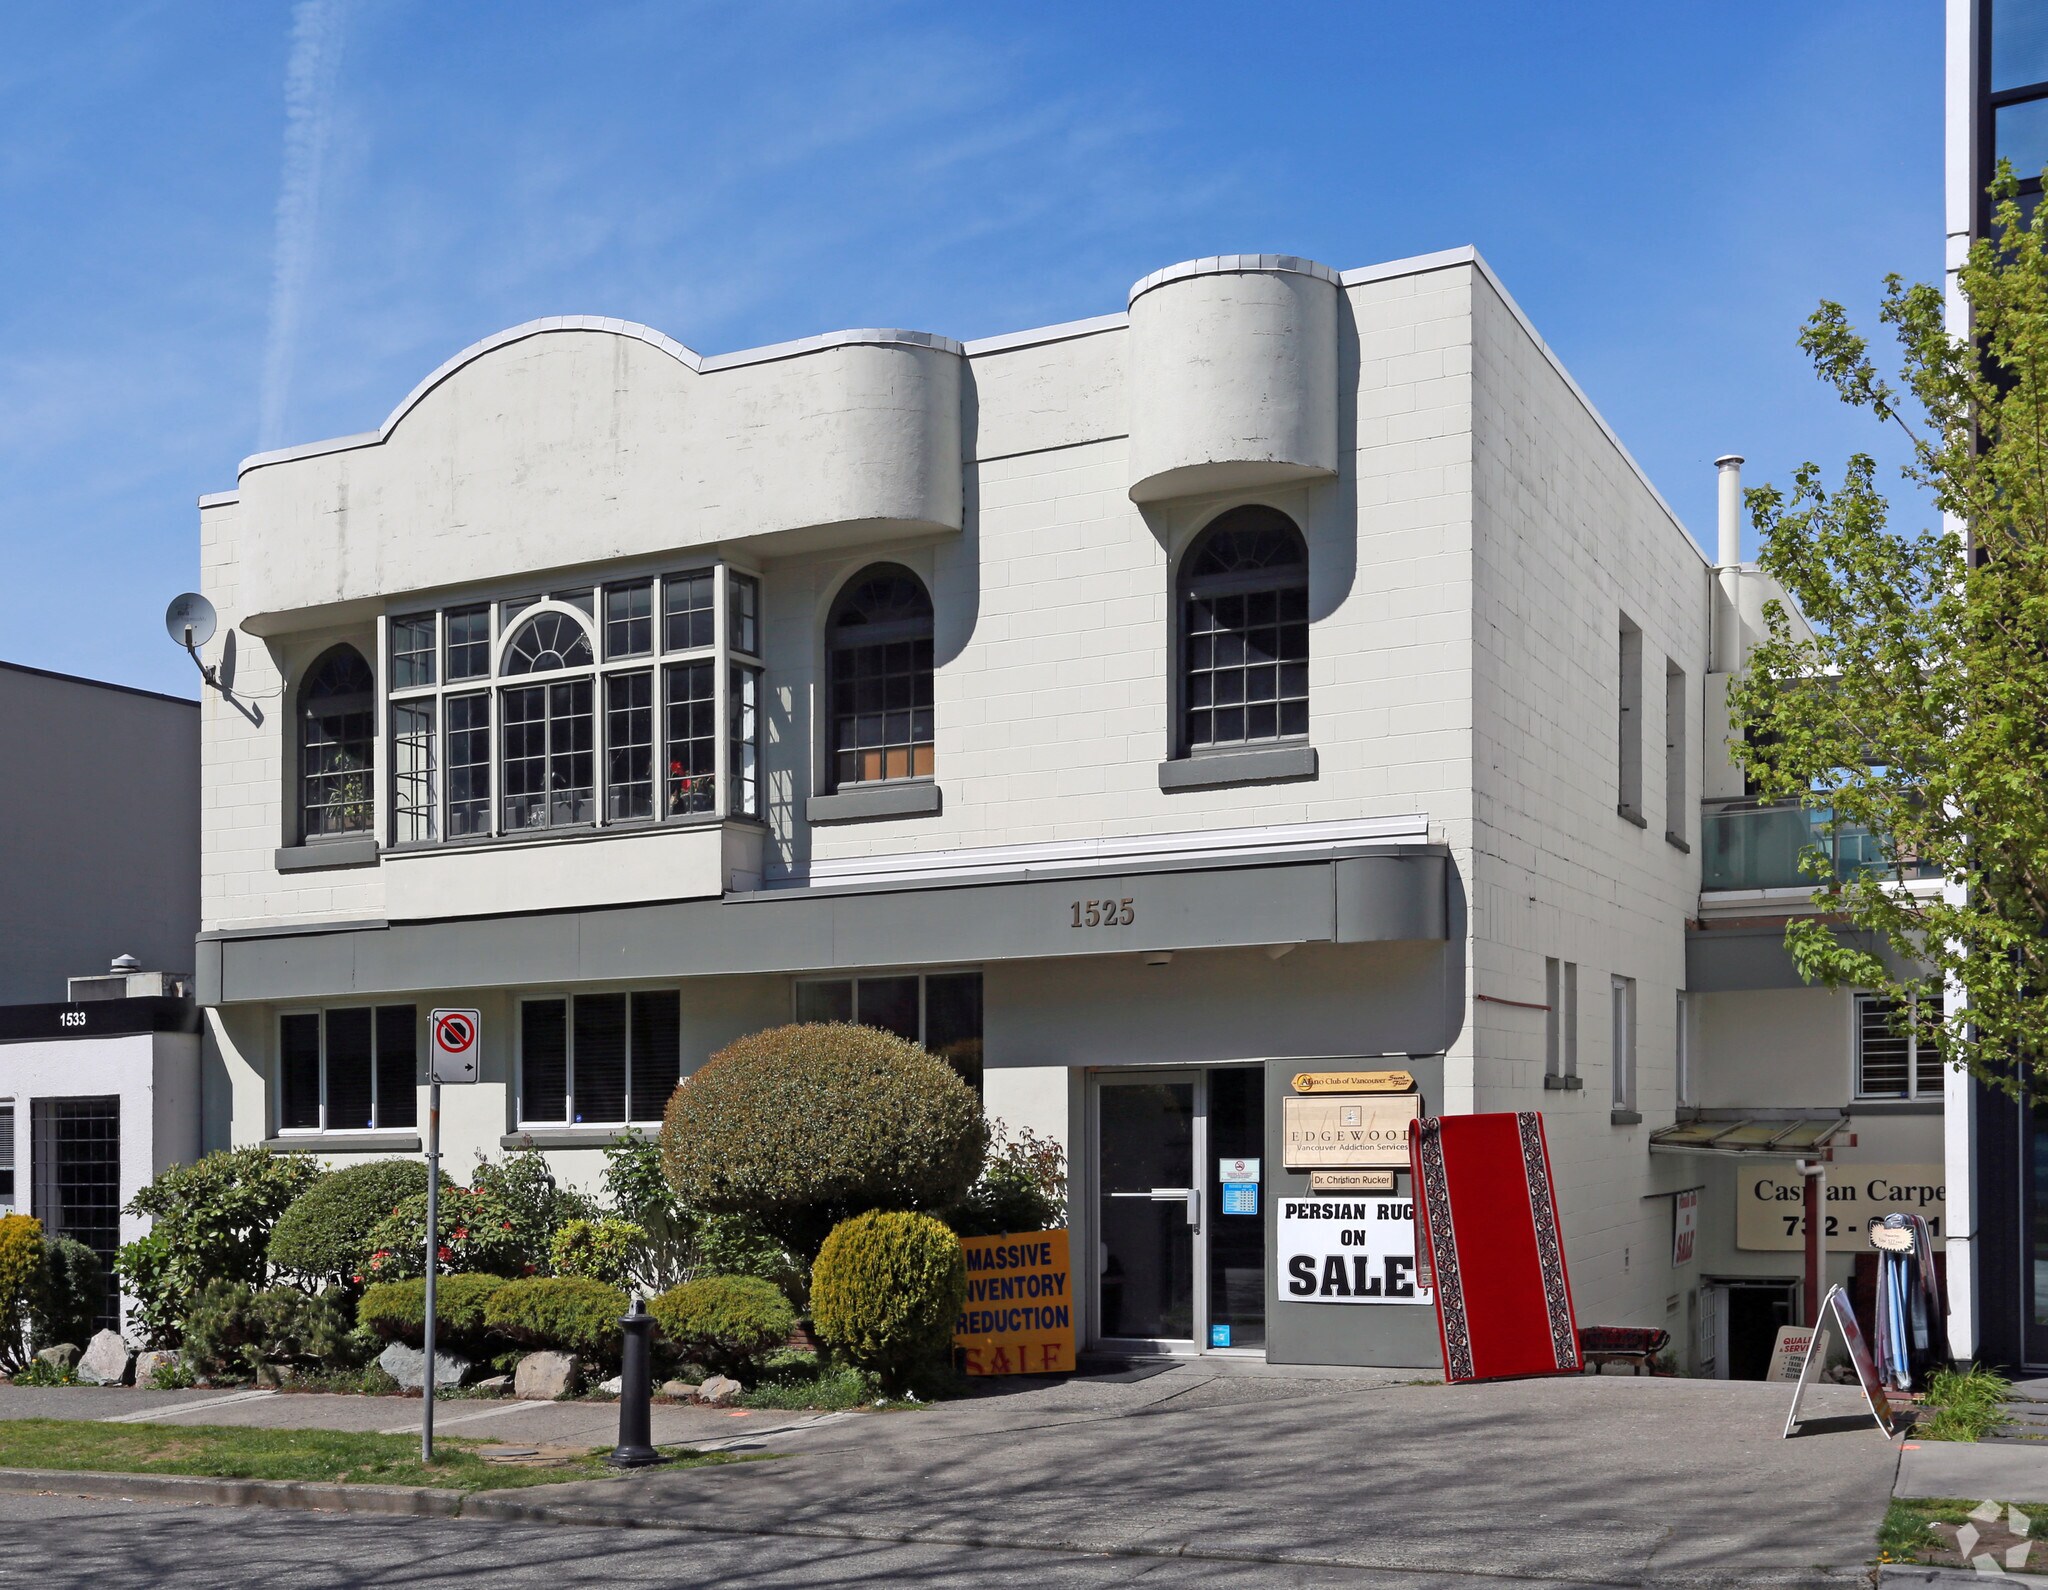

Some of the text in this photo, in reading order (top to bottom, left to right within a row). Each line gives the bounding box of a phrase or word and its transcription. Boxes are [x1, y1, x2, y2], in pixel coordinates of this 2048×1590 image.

[1070, 898, 1135, 928] 1525
[60, 1012, 86, 1026] 1533
[1351, 1077, 1386, 1085] Vancouver
[1339, 1143, 1375, 1151] Addiction
[1377, 1143, 1408, 1151] Services
[1314, 1175, 1390, 1184] Dr. Christian Rucker
[1754, 1179, 1946, 1207] Casan Carpe
[1285, 1203, 1366, 1220] PERSIAN
[1783, 1216, 1838, 1236] 72
[1340, 1229, 1366, 1246] ON
[966, 1243, 1052, 1272] MASSIVE
[1288, 1254, 1415, 1298] SALE
[966, 1272, 1066, 1302] NVENTORY
[956, 1305, 1069, 1335] REDUCTION
[1783, 1337, 1812, 1345] QUALI
[1784, 1343, 1822, 1353] SERVIE
